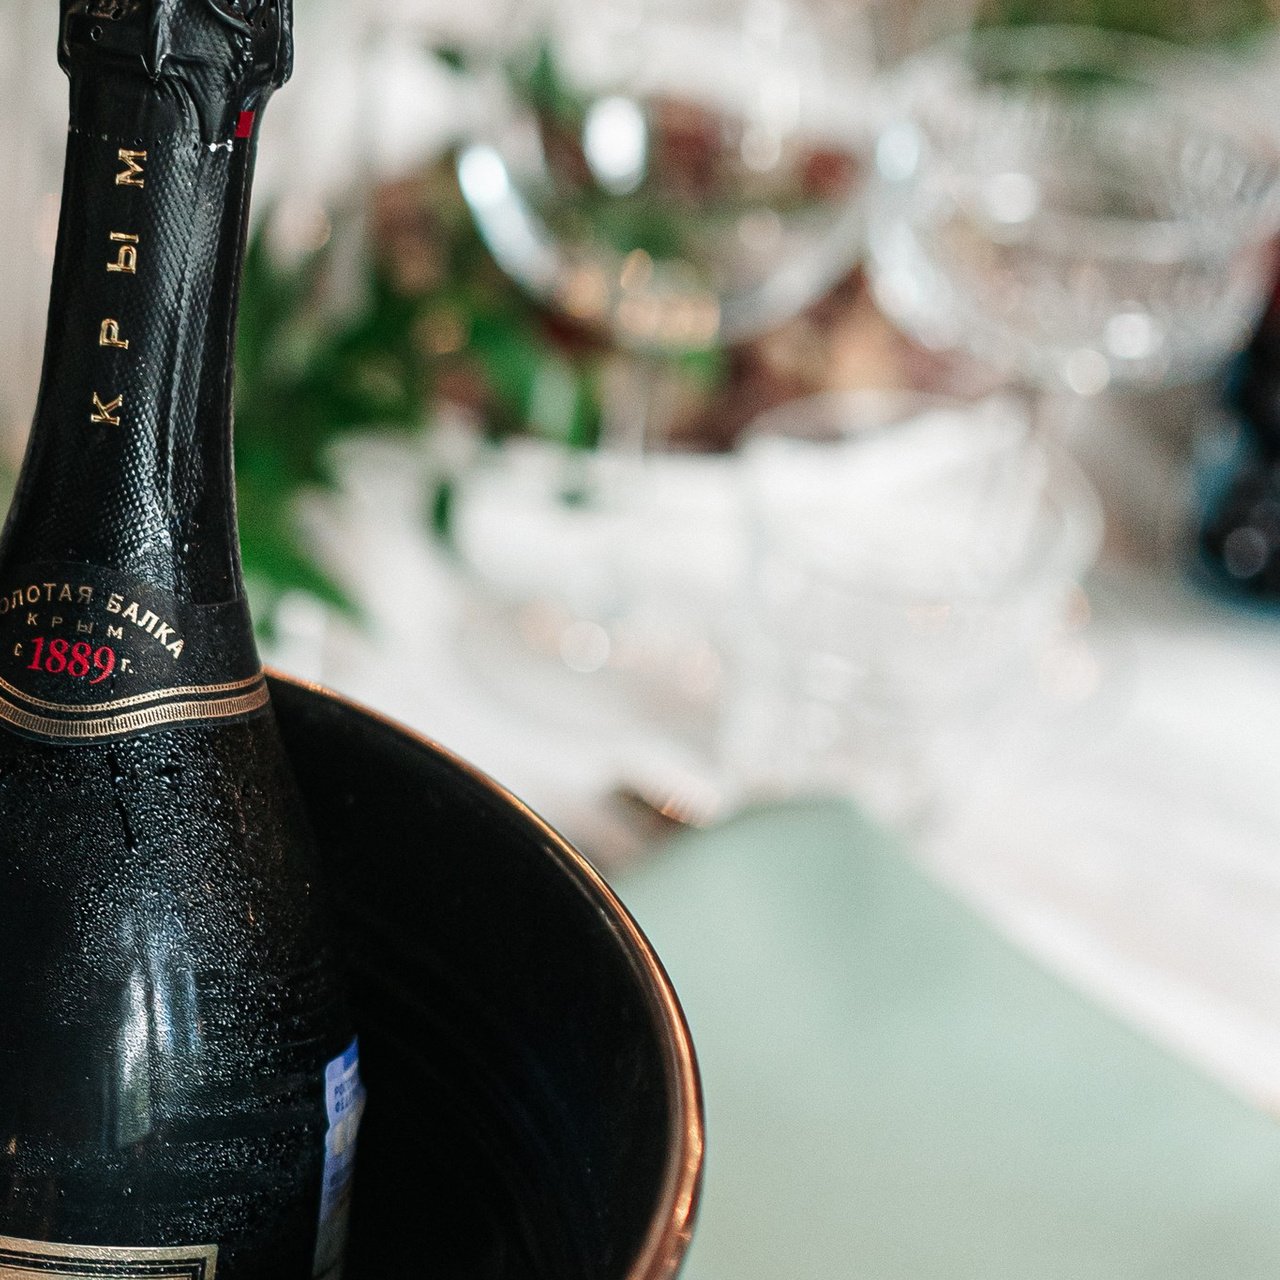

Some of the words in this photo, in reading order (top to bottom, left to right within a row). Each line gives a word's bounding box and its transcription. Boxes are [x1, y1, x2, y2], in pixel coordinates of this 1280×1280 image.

[90, 148, 148, 426] КРЫМ
[27, 612, 124, 640] КРЫМ
[106, 592, 187, 659] БАЛКА
[26, 635, 116, 685] 1889
